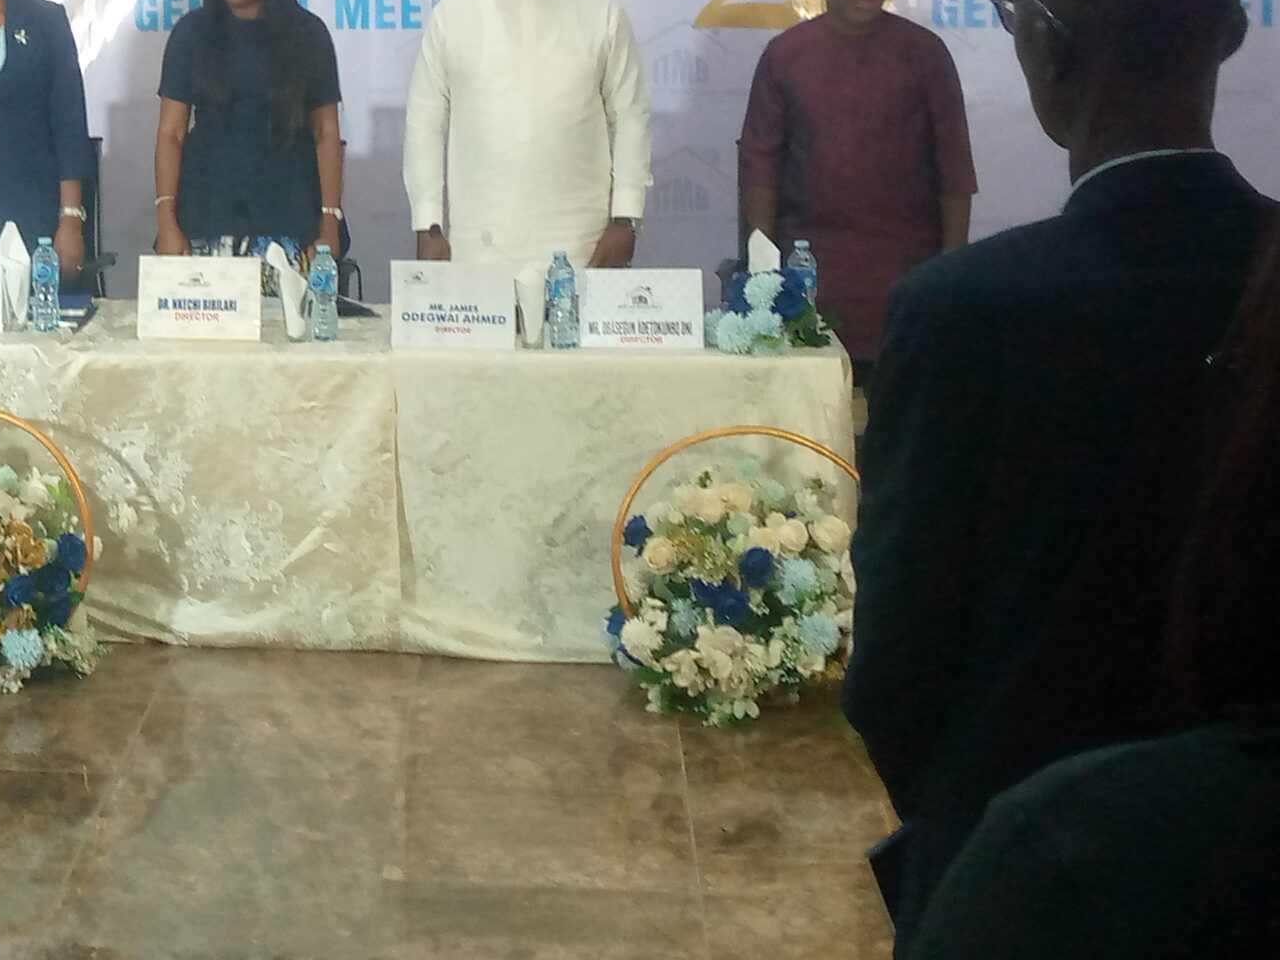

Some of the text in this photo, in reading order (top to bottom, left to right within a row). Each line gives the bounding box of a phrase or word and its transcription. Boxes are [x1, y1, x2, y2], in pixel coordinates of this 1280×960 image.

[449, 304, 479, 313] JAMES
[174, 312, 220, 322] DIRECTOR
[463, 314, 507, 325] AHMED
[435, 325, 471, 334] DIRECTOR
